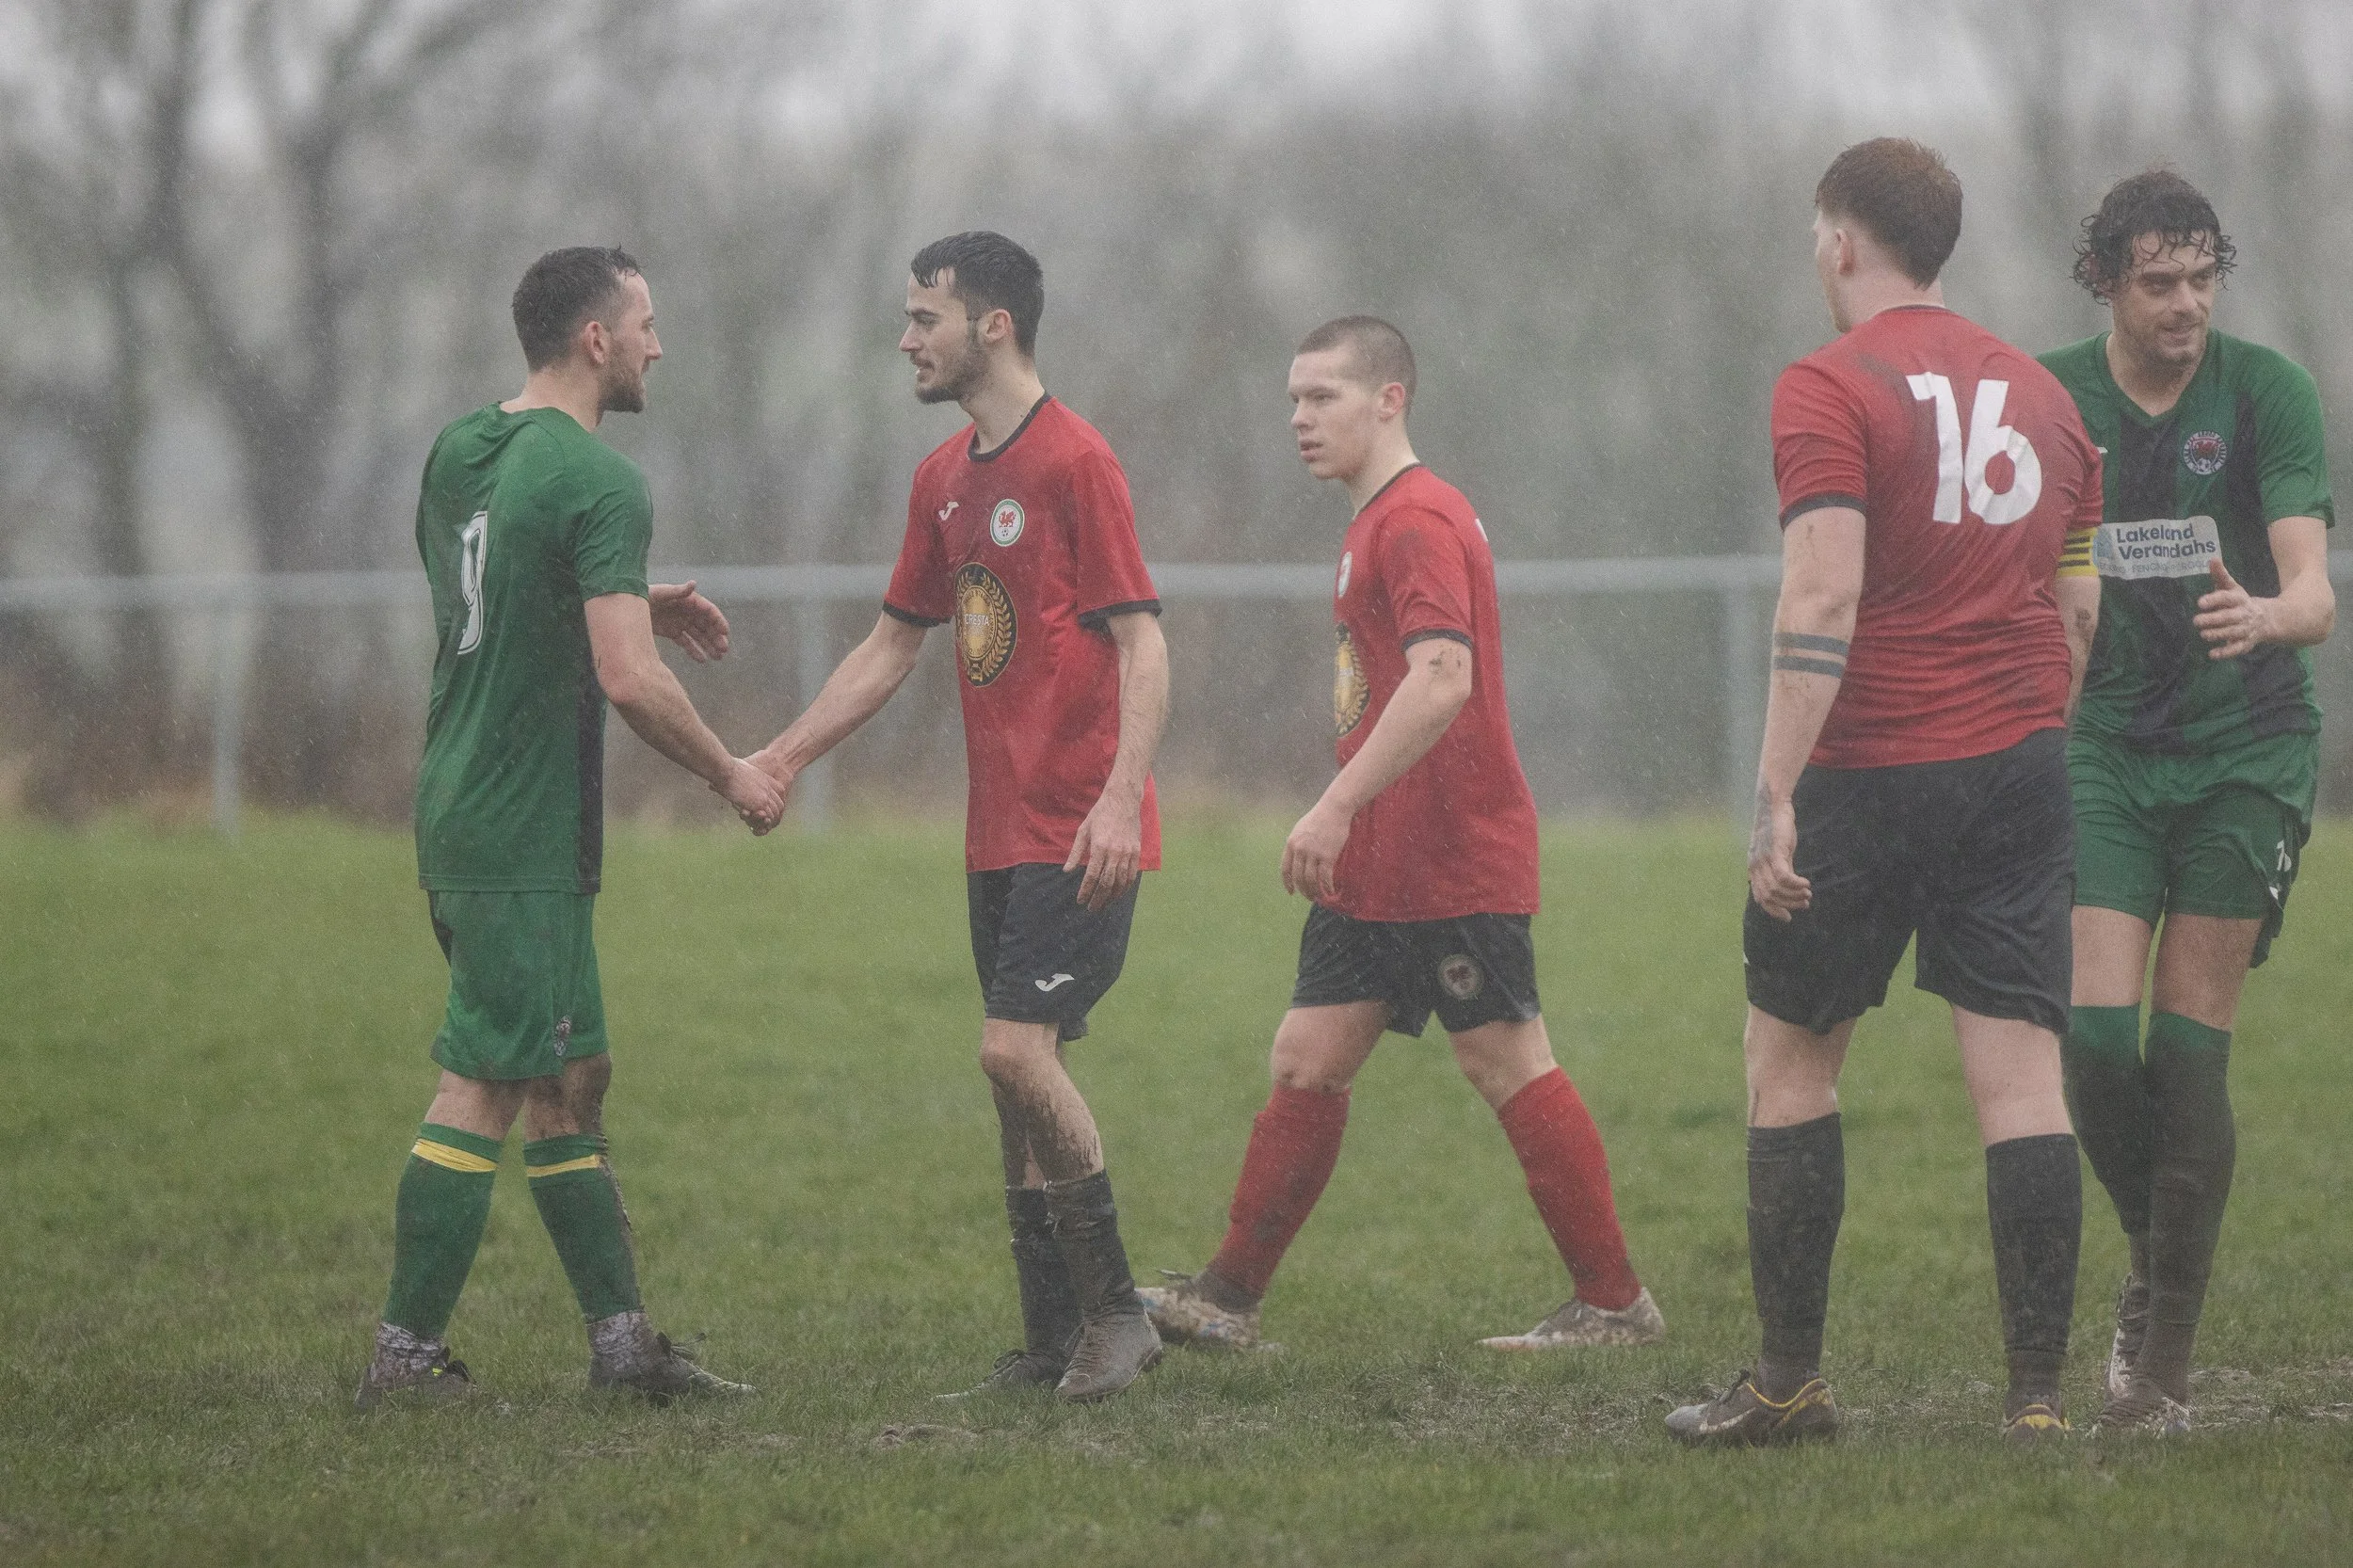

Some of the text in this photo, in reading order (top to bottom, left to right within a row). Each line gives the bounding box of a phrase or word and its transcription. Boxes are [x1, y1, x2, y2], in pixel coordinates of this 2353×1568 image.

[1905, 372, 2042, 524] 16
[2117, 523, 2195, 543] Lakeland
[2119, 539, 2217, 560] Verandahs
[457, 511, 488, 654] 9
